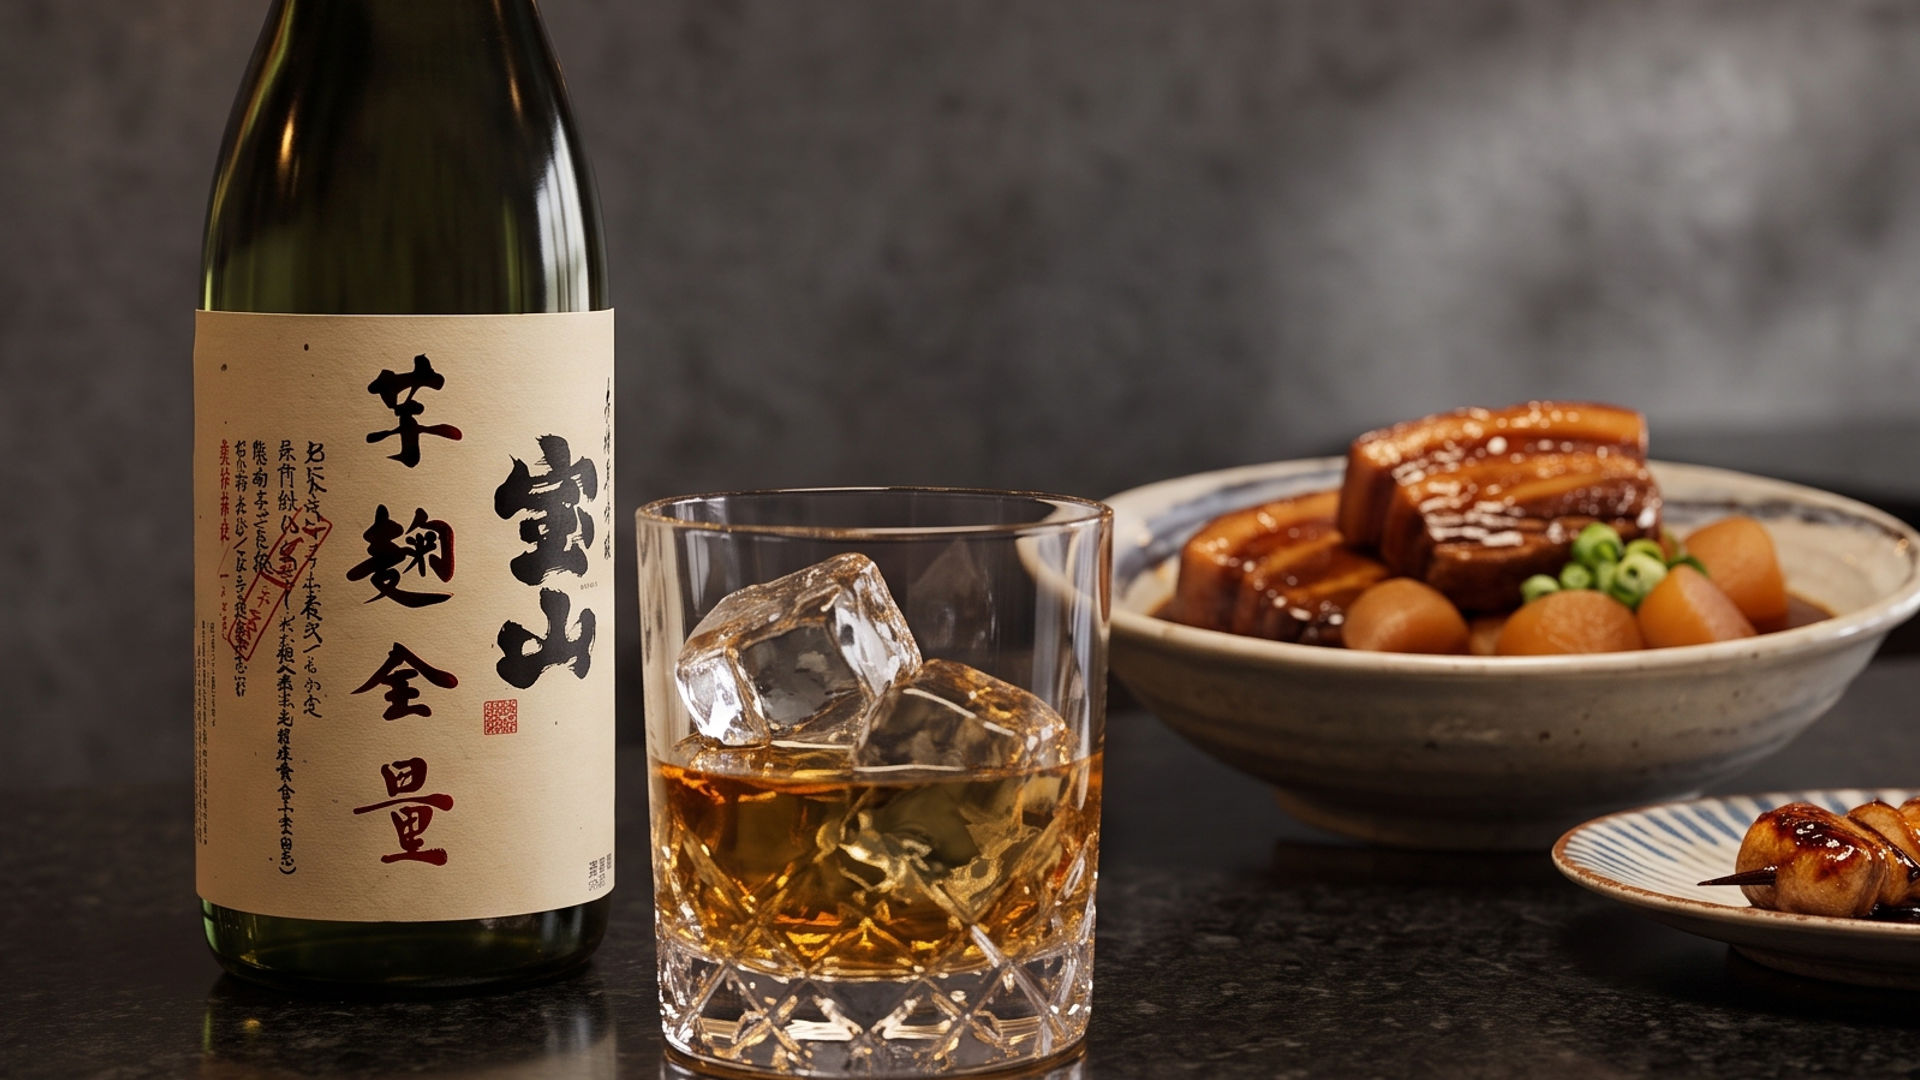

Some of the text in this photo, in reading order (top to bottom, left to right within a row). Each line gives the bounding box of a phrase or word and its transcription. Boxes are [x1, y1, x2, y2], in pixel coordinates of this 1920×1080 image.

[346, 353, 462, 866] 芋麹全量
[494, 434, 598, 689] 宝山
